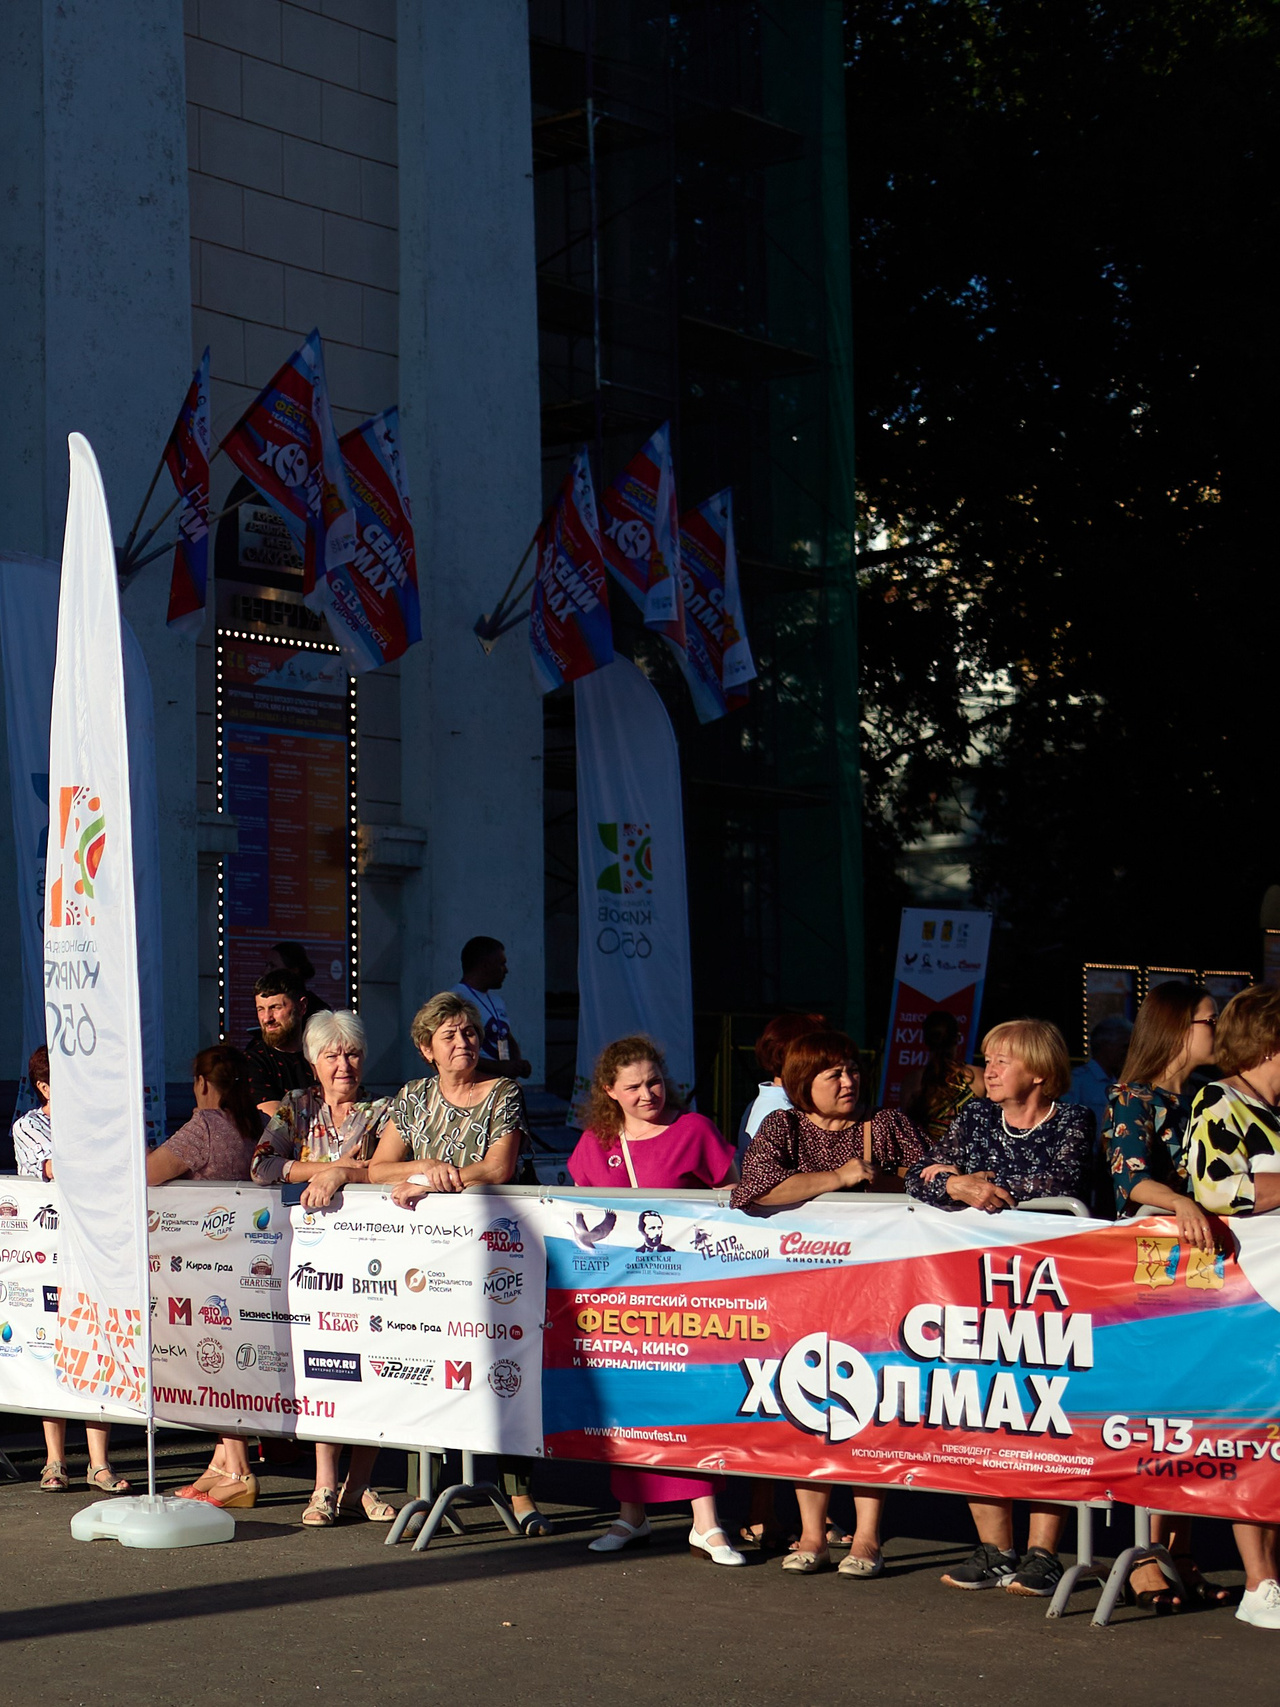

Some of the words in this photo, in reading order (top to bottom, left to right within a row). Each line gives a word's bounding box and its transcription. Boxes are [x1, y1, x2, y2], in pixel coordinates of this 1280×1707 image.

[361, 524, 410, 588] СЕМИ
[352, 545, 396, 600] МАХ
[578, 560, 606, 592] НА
[331, 578, 361, 612] 6-13
[331, 600, 359, 632] КИРОВ
[162, 1211, 177, 1219] Союз
[201, 1211, 237, 1233] МОРЕ
[161, 1219, 199, 1228] журналистов
[161, 1225, 182, 1233] России
[216, 1226, 234, 1236] ПАРК
[245, 1231, 283, 1242] ПЕРВЫЙ
[478, 1231, 510, 1243] АВТО
[780, 1231, 852, 1257] Смена
[487, 1241, 525, 1254] РАДИО
[698, 1234, 738, 1262] ТЕАТР
[721, 1246, 770, 1263] СПАССКОЙ
[734, 1242, 745, 1252] НА
[186, 1261, 212, 1272] Киров
[214, 1261, 234, 1273] Град
[572, 1260, 610, 1272] ТЕАТР
[625, 1262, 682, 1271] ФИЛАРМОНИЯ
[635, 1255, 672, 1263] ВЯТСКАЯ
[786, 1257, 844, 1265] КИНОТЕАТР
[427, 1270, 446, 1278] Союз
[976, 1252, 1071, 1308] НА
[239, 1278, 282, 1289] CHARUSHIN
[352, 1277, 399, 1297] ВЯТИЧ
[428, 1278, 473, 1288] журналистов
[483, 1272, 523, 1296] МОРЕ
[503, 1288, 523, 1299] ПАРК
[574, 1292, 627, 1305] ВТОРОЙ
[629, 1294, 688, 1308] ВЯТСКИЙ
[690, 1297, 768, 1311] ОТКРЫТЫЙ
[198, 1306, 221, 1318] АВТО
[204, 1315, 233, 1327] РАДИО
[387, 1320, 417, 1332] Киров
[420, 1322, 442, 1334] Град
[576, 1308, 772, 1341] ФЕСТИВАЛЬ
[447, 1321, 507, 1340] МАРИЯ
[900, 1303, 1096, 1369] СЕМИ
[151, 1343, 188, 1358] ЛЬКИ
[573, 1338, 638, 1356] ТЕАТРА,
[641, 1341, 690, 1357] КИНО
[308, 1356, 357, 1370] KIROV.RU
[573, 1357, 581, 1366] И
[585, 1358, 686, 1373] ЖУРНАЛИСТИКИ
[737, 1330, 1075, 1444] ХОЛМАХ
[584, 1426, 688, 1442] www.7holmovfest.ru
[1102, 1414, 1194, 1453] 6-13
[851, 1449, 931, 1463] ИСПОЛНИТЕЛЬНЫЙ
[932, 1455, 977, 1467] ДИРЕКТОР
[982, 1459, 1043, 1472] КОНСТАНТИН
[1044, 1463, 1092, 1476] ЗАЙНУЛИН
[942, 1444, 991, 1456] ПРЕЗИДЕНТ
[998, 1448, 1033, 1462] СЕРГЕЙ
[1034, 1452, 1095, 1466] НОВОЖИЛОВ
[1136, 1457, 1238, 1481] КИРОВ
